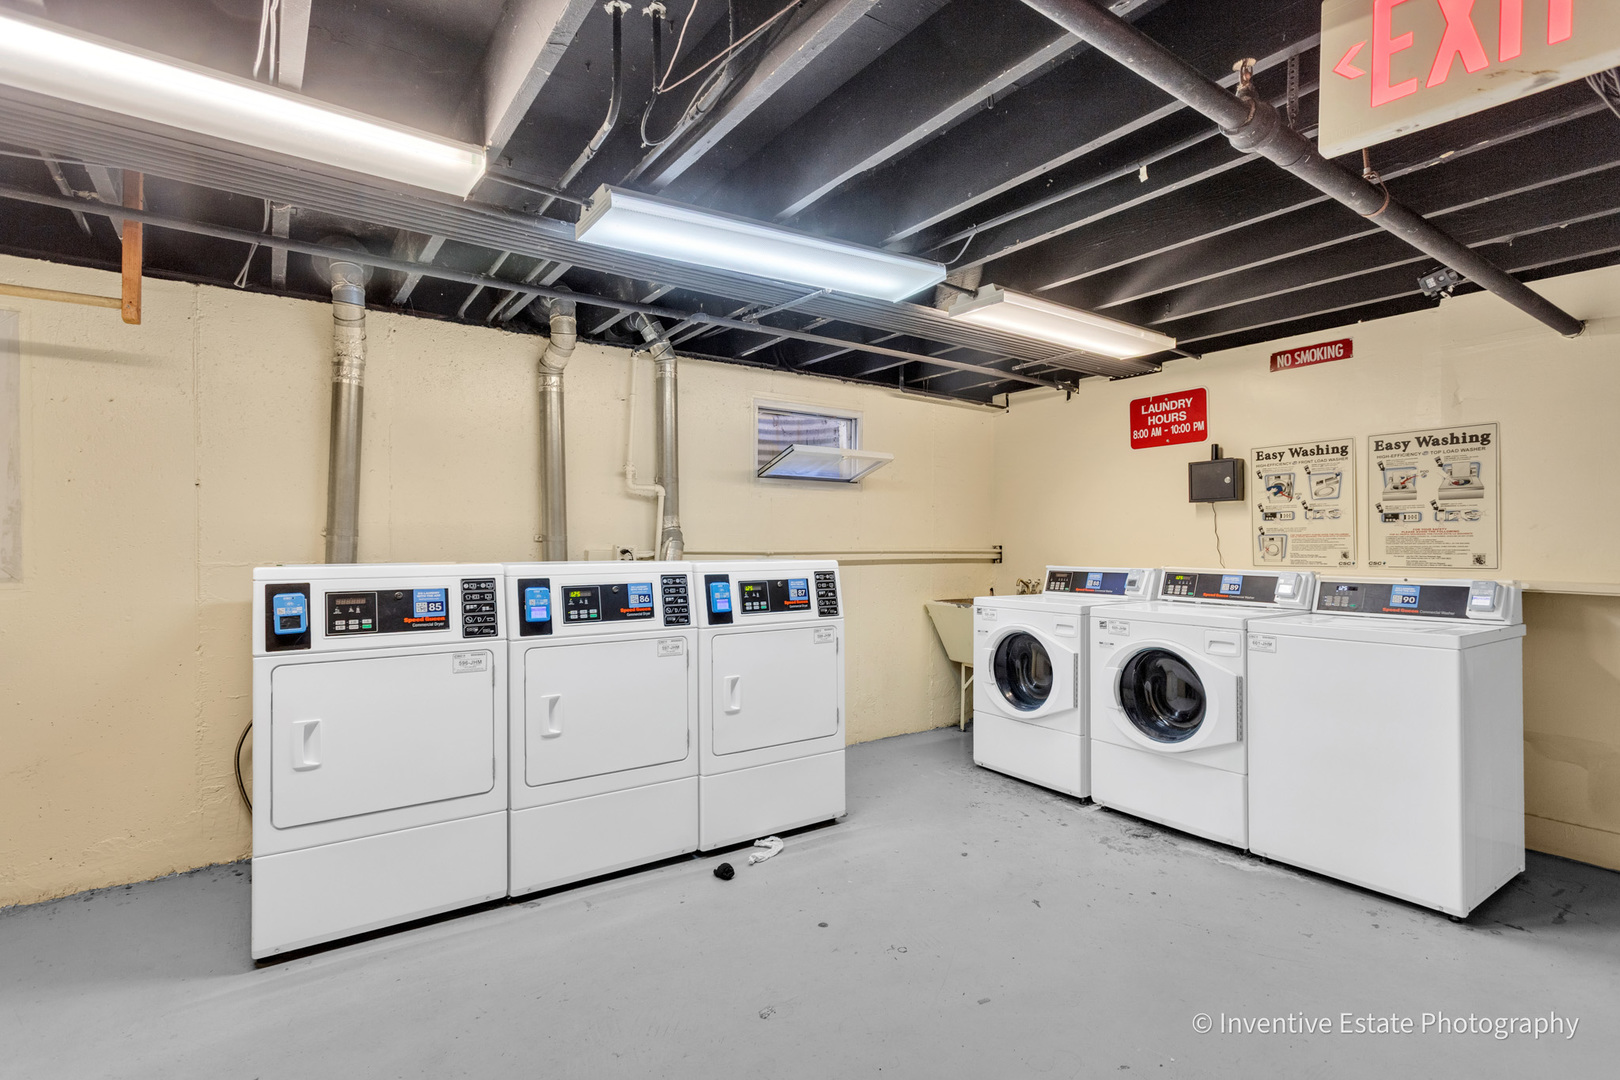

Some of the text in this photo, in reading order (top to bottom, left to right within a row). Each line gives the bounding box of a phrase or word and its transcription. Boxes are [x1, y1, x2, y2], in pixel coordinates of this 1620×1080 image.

[1276, 343, 1344, 369] NO SMOKING
[1141, 397, 1193, 415] LAUNDRY
[1147, 411, 1187, 426] HOURS
[1132, 429, 1149, 440] 8:00
[1150, 427, 1162, 437] AM
[1170, 423, 1191, 435] 10:00
[1193, 421, 1205, 432] PM
[1374, 432, 1491, 452] Easy Washing
[1256, 444, 1349, 462] Easy Washing
[1376, 451, 1421, 459] HIGH-EFFICIENCY
[639, 595, 650, 603] 86
[797, 589, 806, 597] 87
[1402, 596, 1416, 604] 90
[428, 602, 442, 612] 85
[403, 616, 424, 624] Speed
